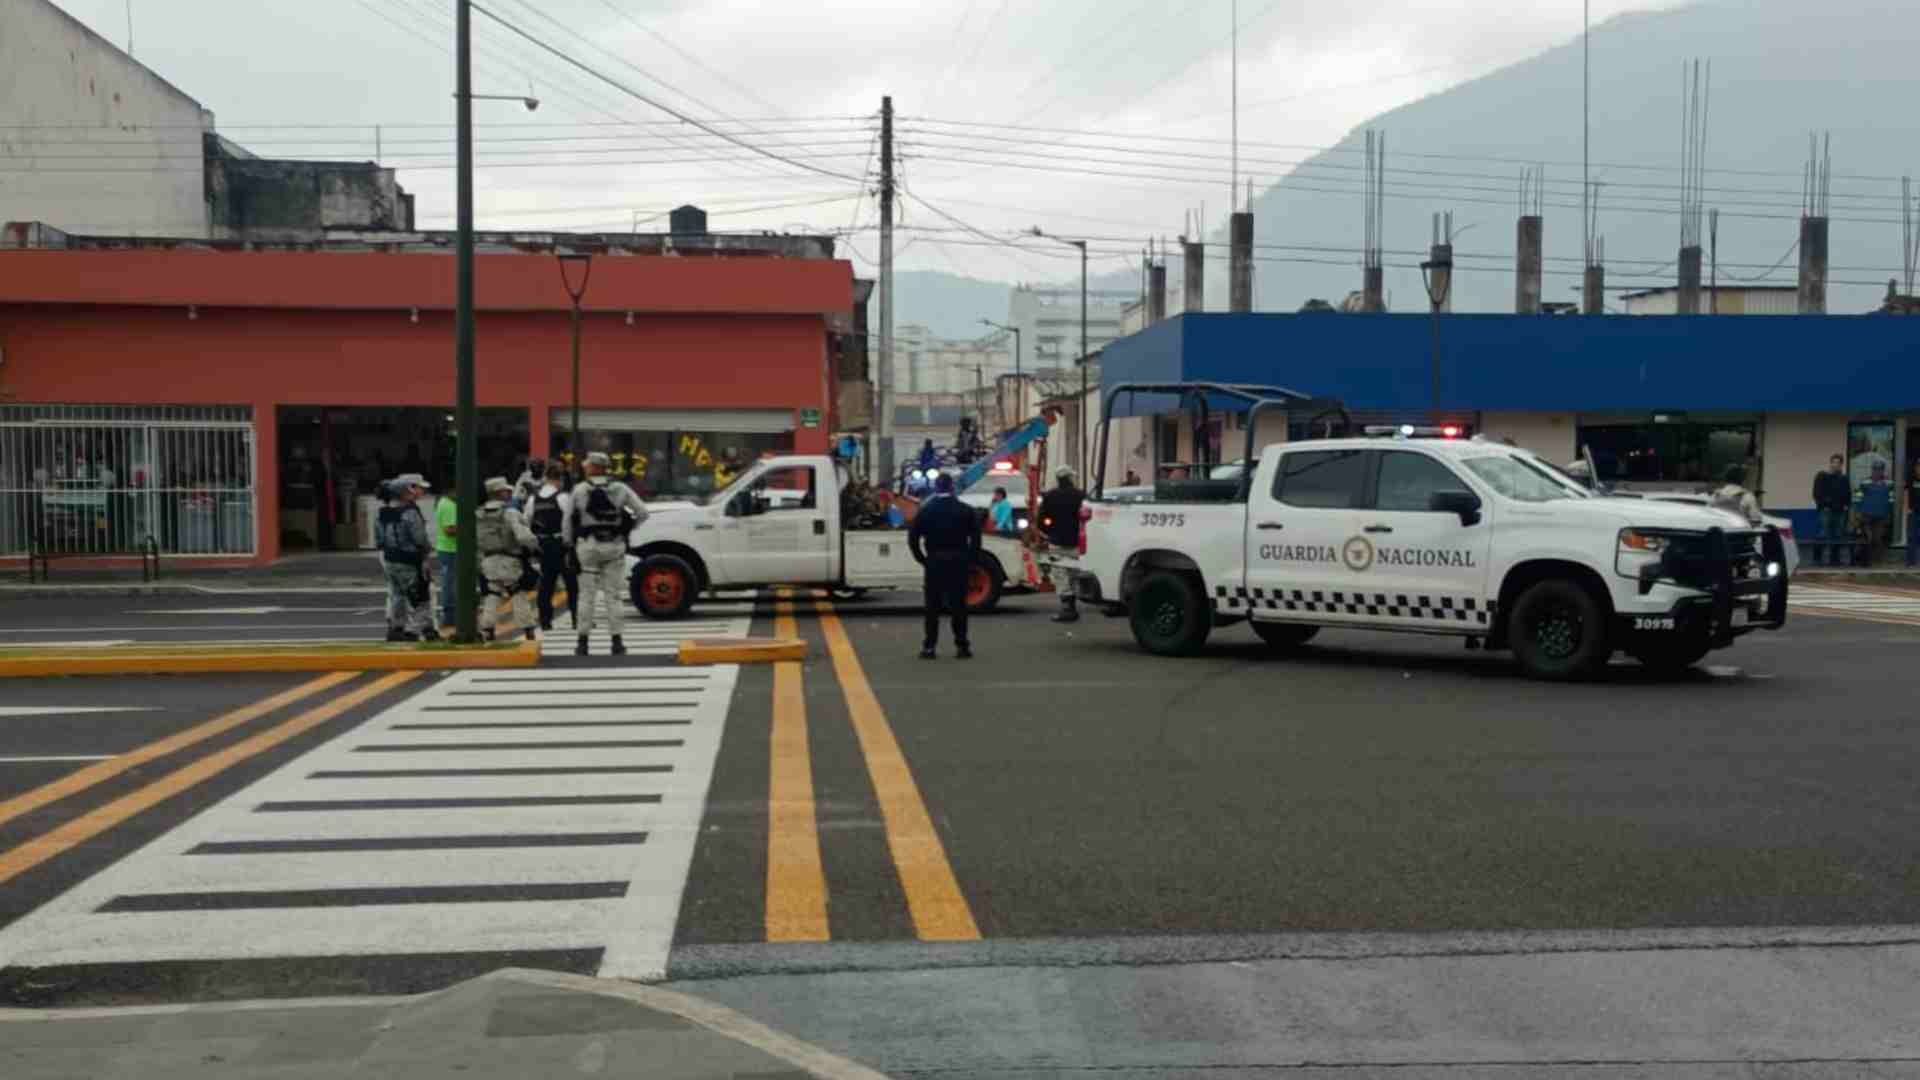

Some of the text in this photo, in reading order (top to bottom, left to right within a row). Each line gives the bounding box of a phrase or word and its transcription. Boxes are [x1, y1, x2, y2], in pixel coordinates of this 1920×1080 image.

[1140, 512, 1185, 527] 30975
[1259, 544, 1475, 567] GUARDIA NACIONAL
